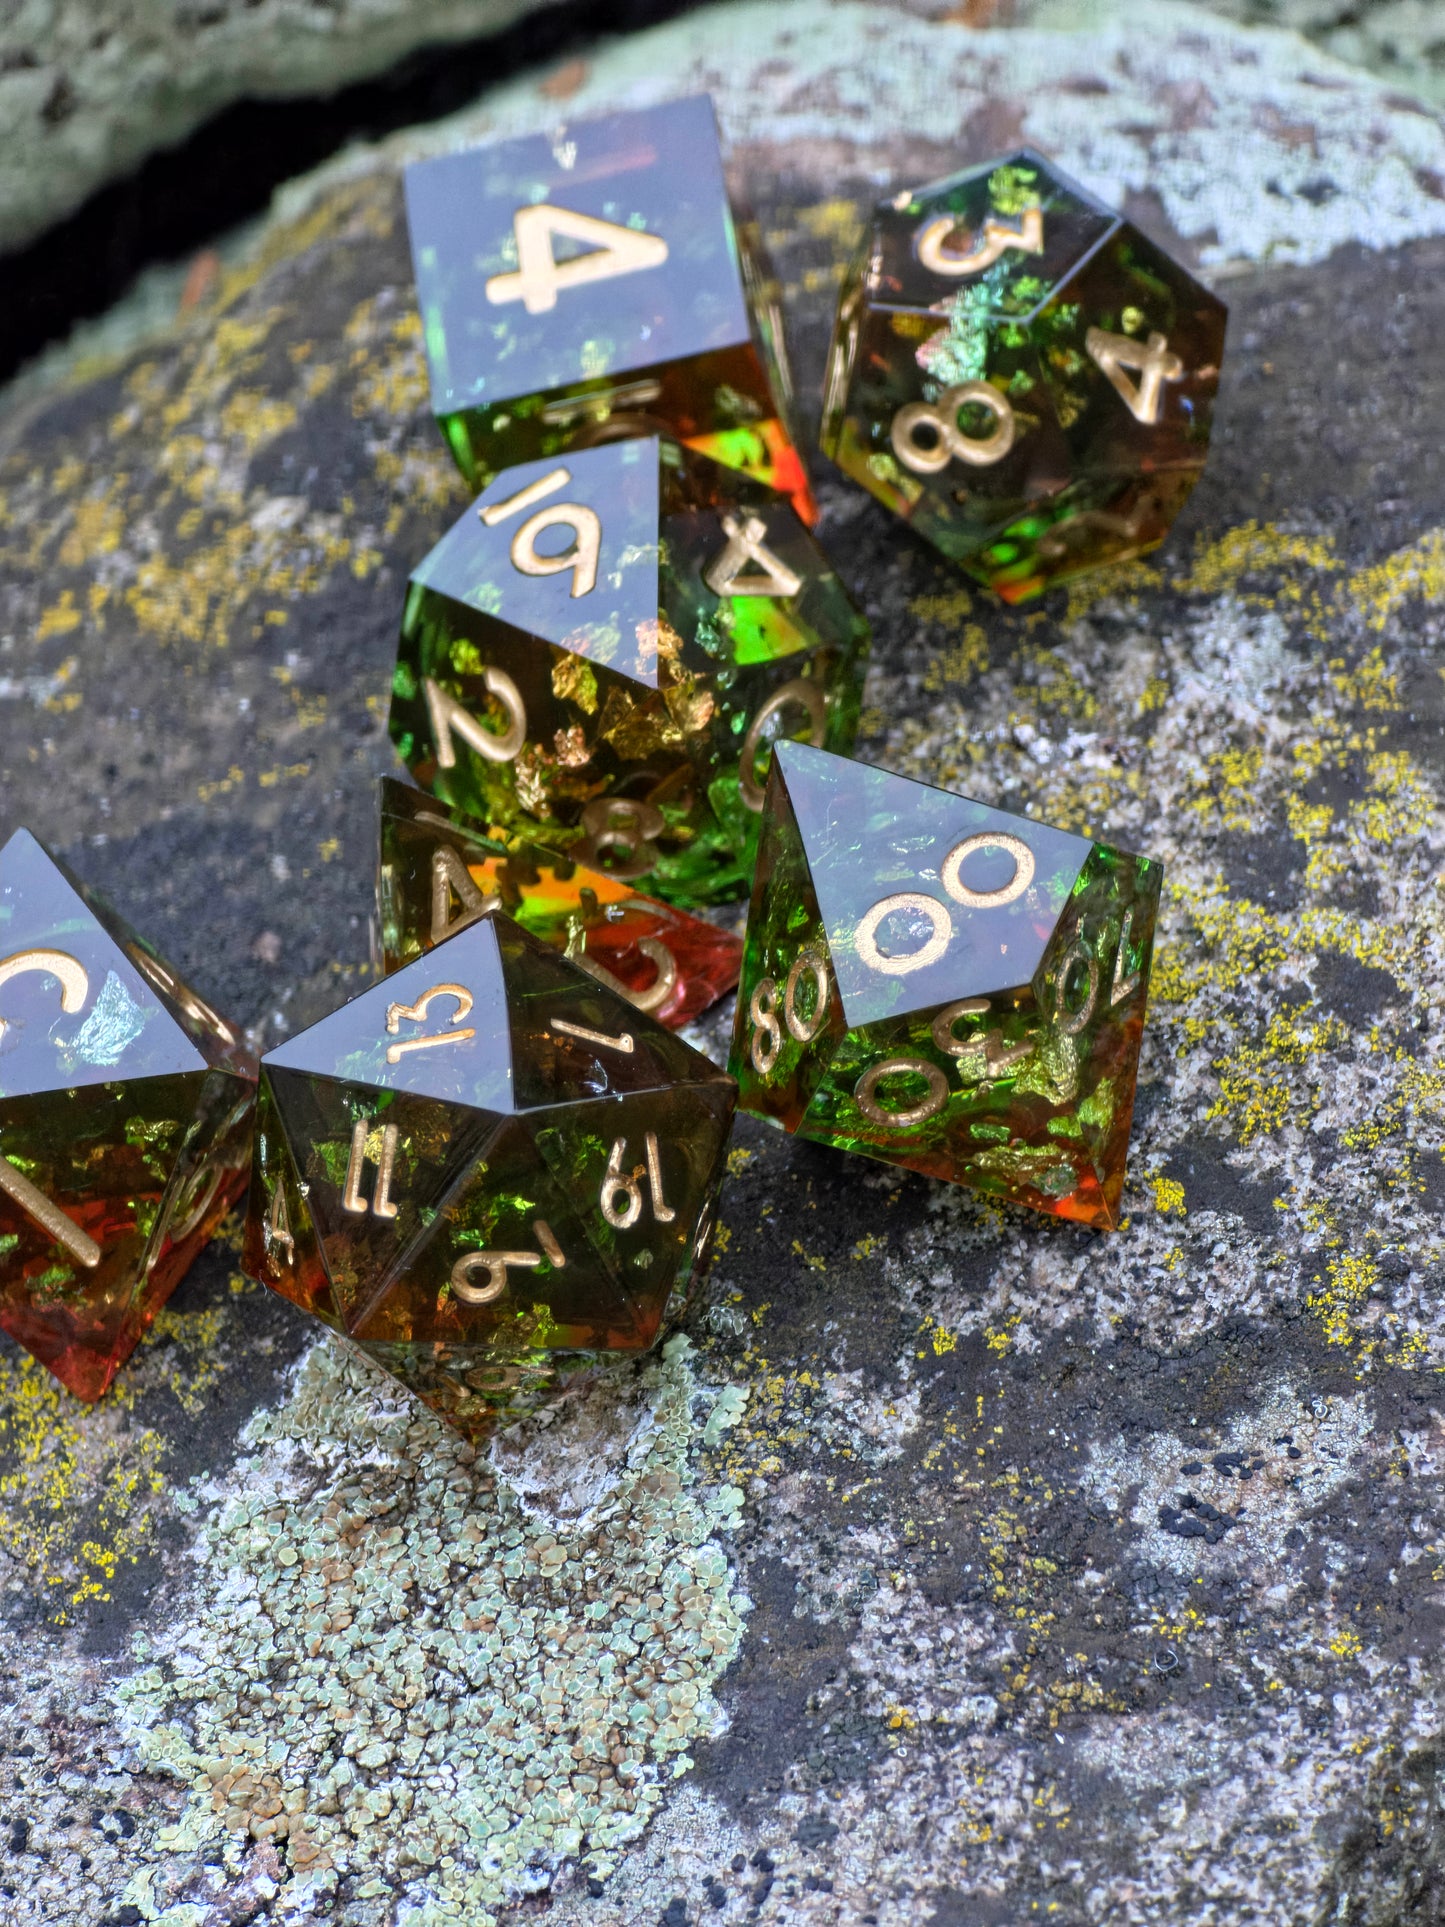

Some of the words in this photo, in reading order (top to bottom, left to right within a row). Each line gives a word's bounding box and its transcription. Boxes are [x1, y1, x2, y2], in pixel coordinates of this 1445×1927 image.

[486, 204, 668, 315] 4
[917, 207, 1045, 277] 3
[1086, 325, 1185, 426] 4
[891, 380, 1015, 475] 8
[705, 515, 801, 597] 4
[424, 666, 528, 768] 2
[853, 831, 1036, 976] 00
[385, 982, 476, 1064] 13
[550, 1017, 635, 1054] 1
[750, 950, 829, 1075] 80
[342, 1118, 399, 1219] 11
